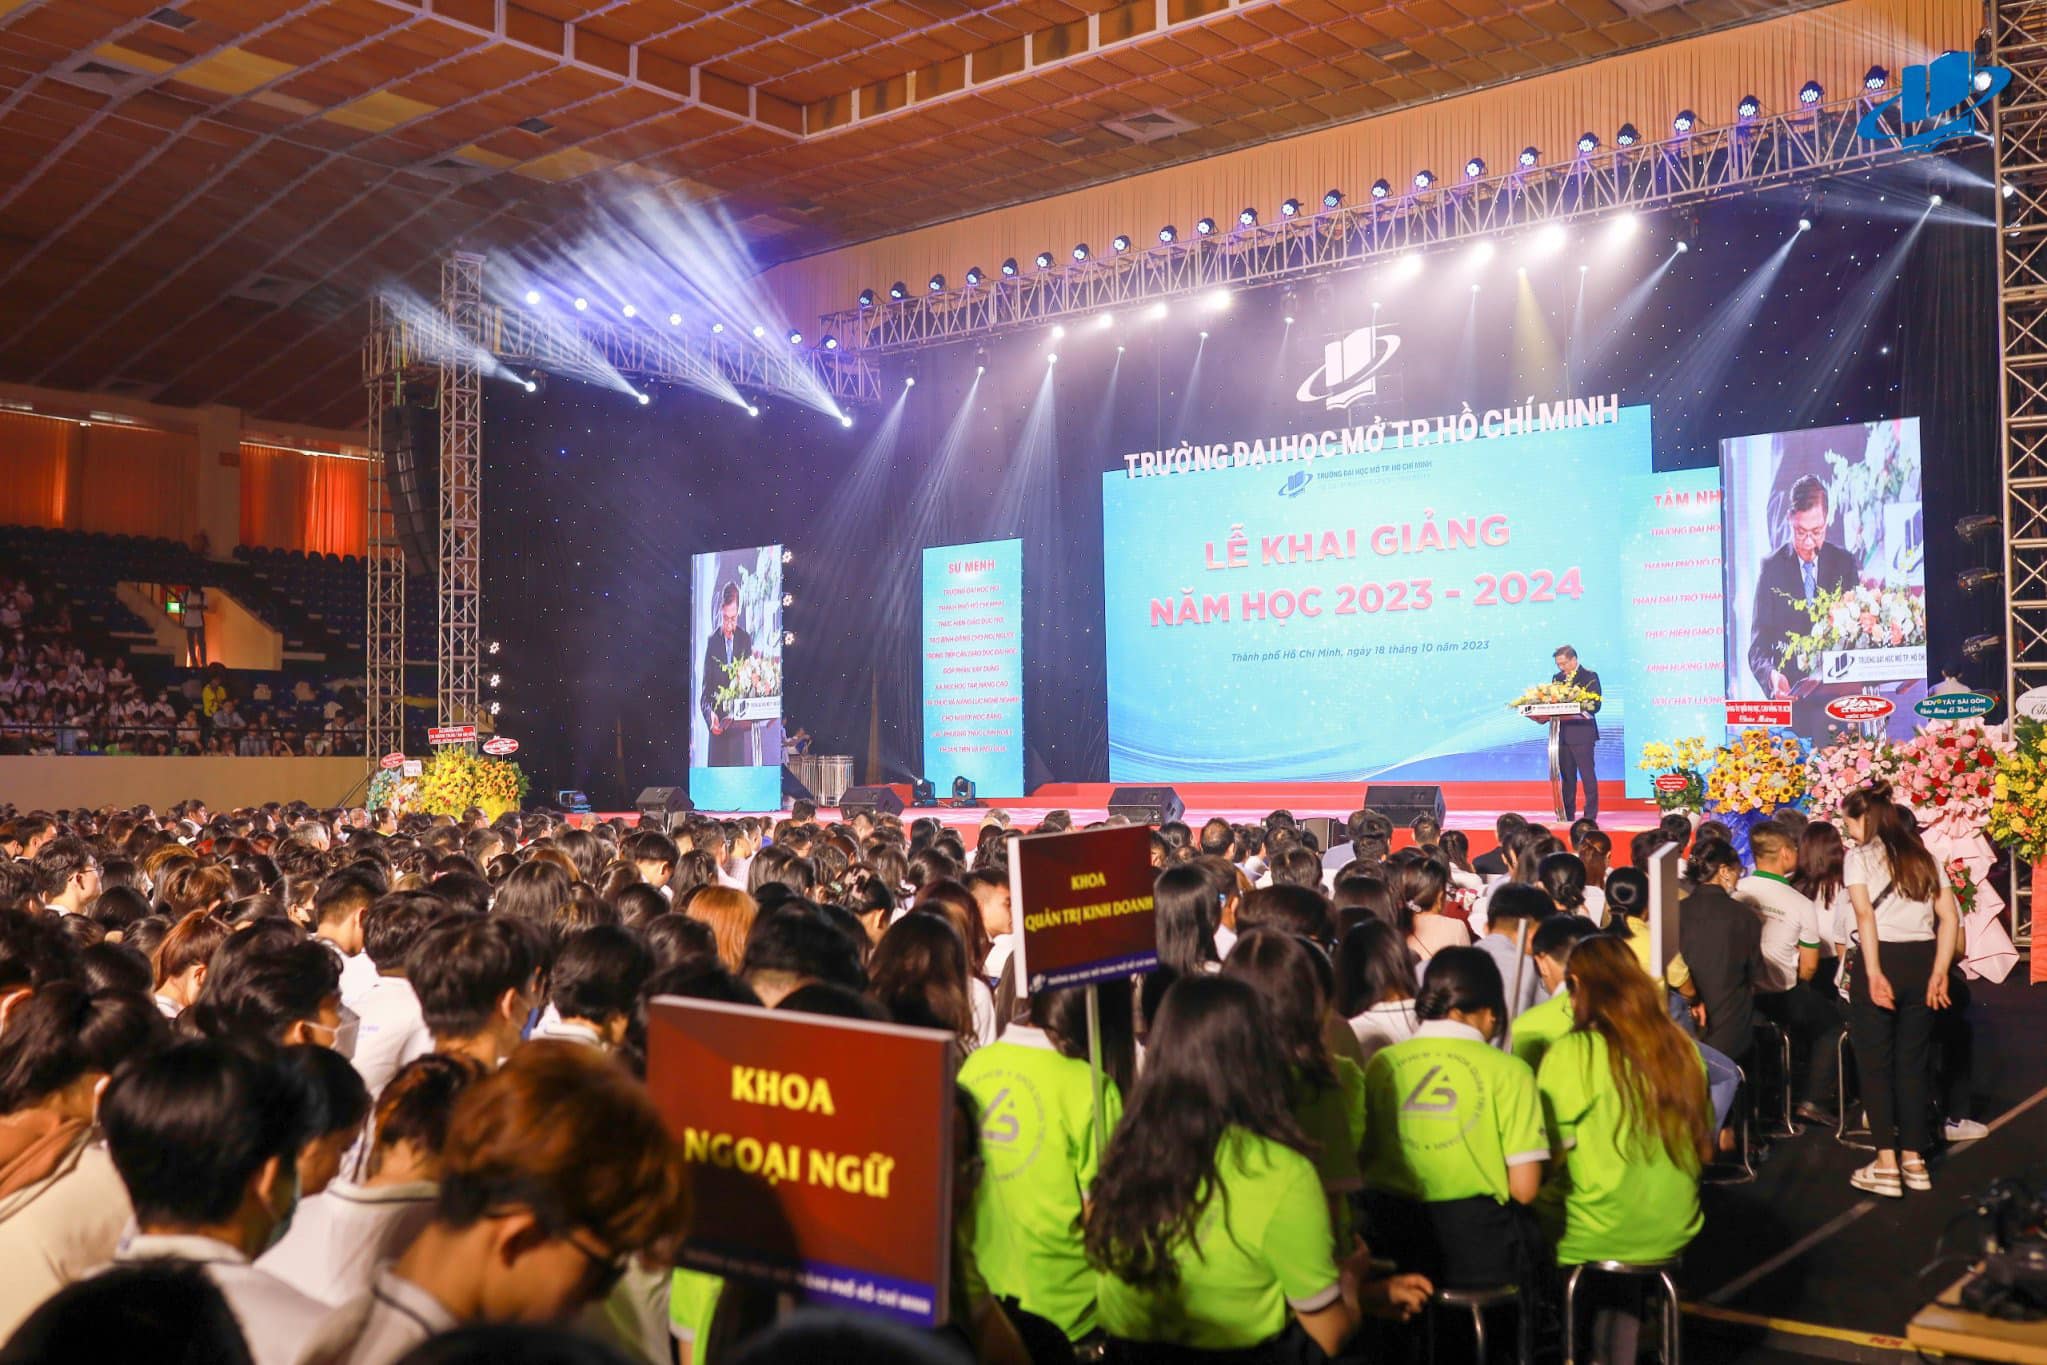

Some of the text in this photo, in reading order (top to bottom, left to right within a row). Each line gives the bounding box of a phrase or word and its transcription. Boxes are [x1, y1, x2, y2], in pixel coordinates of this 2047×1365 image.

[1124, 394, 1619, 479] TRƯỜNG ĐẠI HỌC MỞ TP. HỒ CHÍ MINH
[1696, 489, 1722, 505] NH
[1205, 508, 1510, 570] LỄ KHAI GIẢNG
[1150, 586, 1231, 627] NĂM
[1242, 587, 1323, 627] HỌC
[1335, 578, 1433, 615] 2023
[1473, 566, 1585, 607] 2024
[1231, 652, 1260, 663] Thành
[1375, 645, 1385, 655] 18
[1421, 643, 1433, 653] 10
[1461, 640, 1490, 651] 2023
[1071, 872, 1106, 890] KHOA
[1025, 895, 1154, 932] QUẢN TRỊ KINH DOANH
[731, 1064, 835, 1116] KHOA
[684, 1127, 895, 1199] NGOẠI NGỮ
